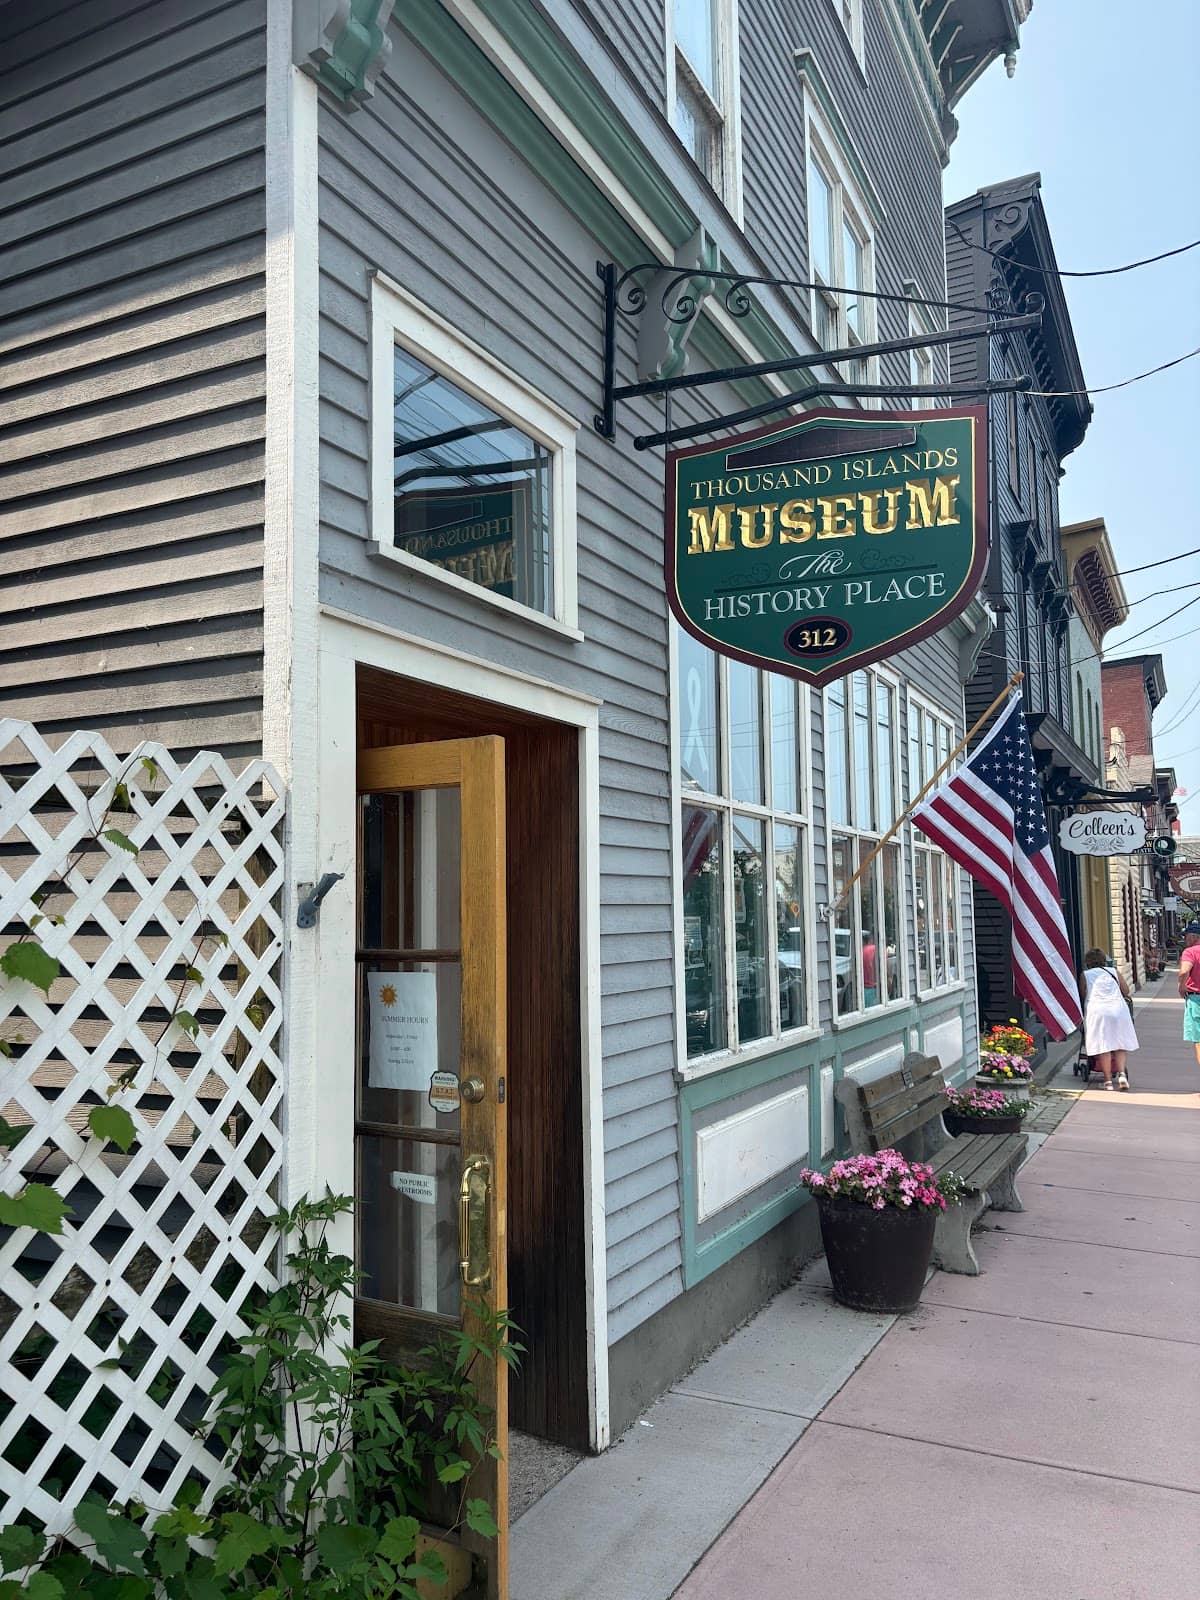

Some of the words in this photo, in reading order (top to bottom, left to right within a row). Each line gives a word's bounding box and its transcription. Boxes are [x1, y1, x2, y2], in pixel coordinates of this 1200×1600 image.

[690, 465, 832, 500] THOUSAND
[842, 448, 959, 481] ISLANDS
[687, 474, 961, 555] MUSEUM
[778, 549, 852, 581] The
[703, 585, 833, 621] HISTORY
[844, 572, 947, 607] PLACE
[797, 628, 838, 649] 312
[1068, 817, 1136, 839] Colleen's
